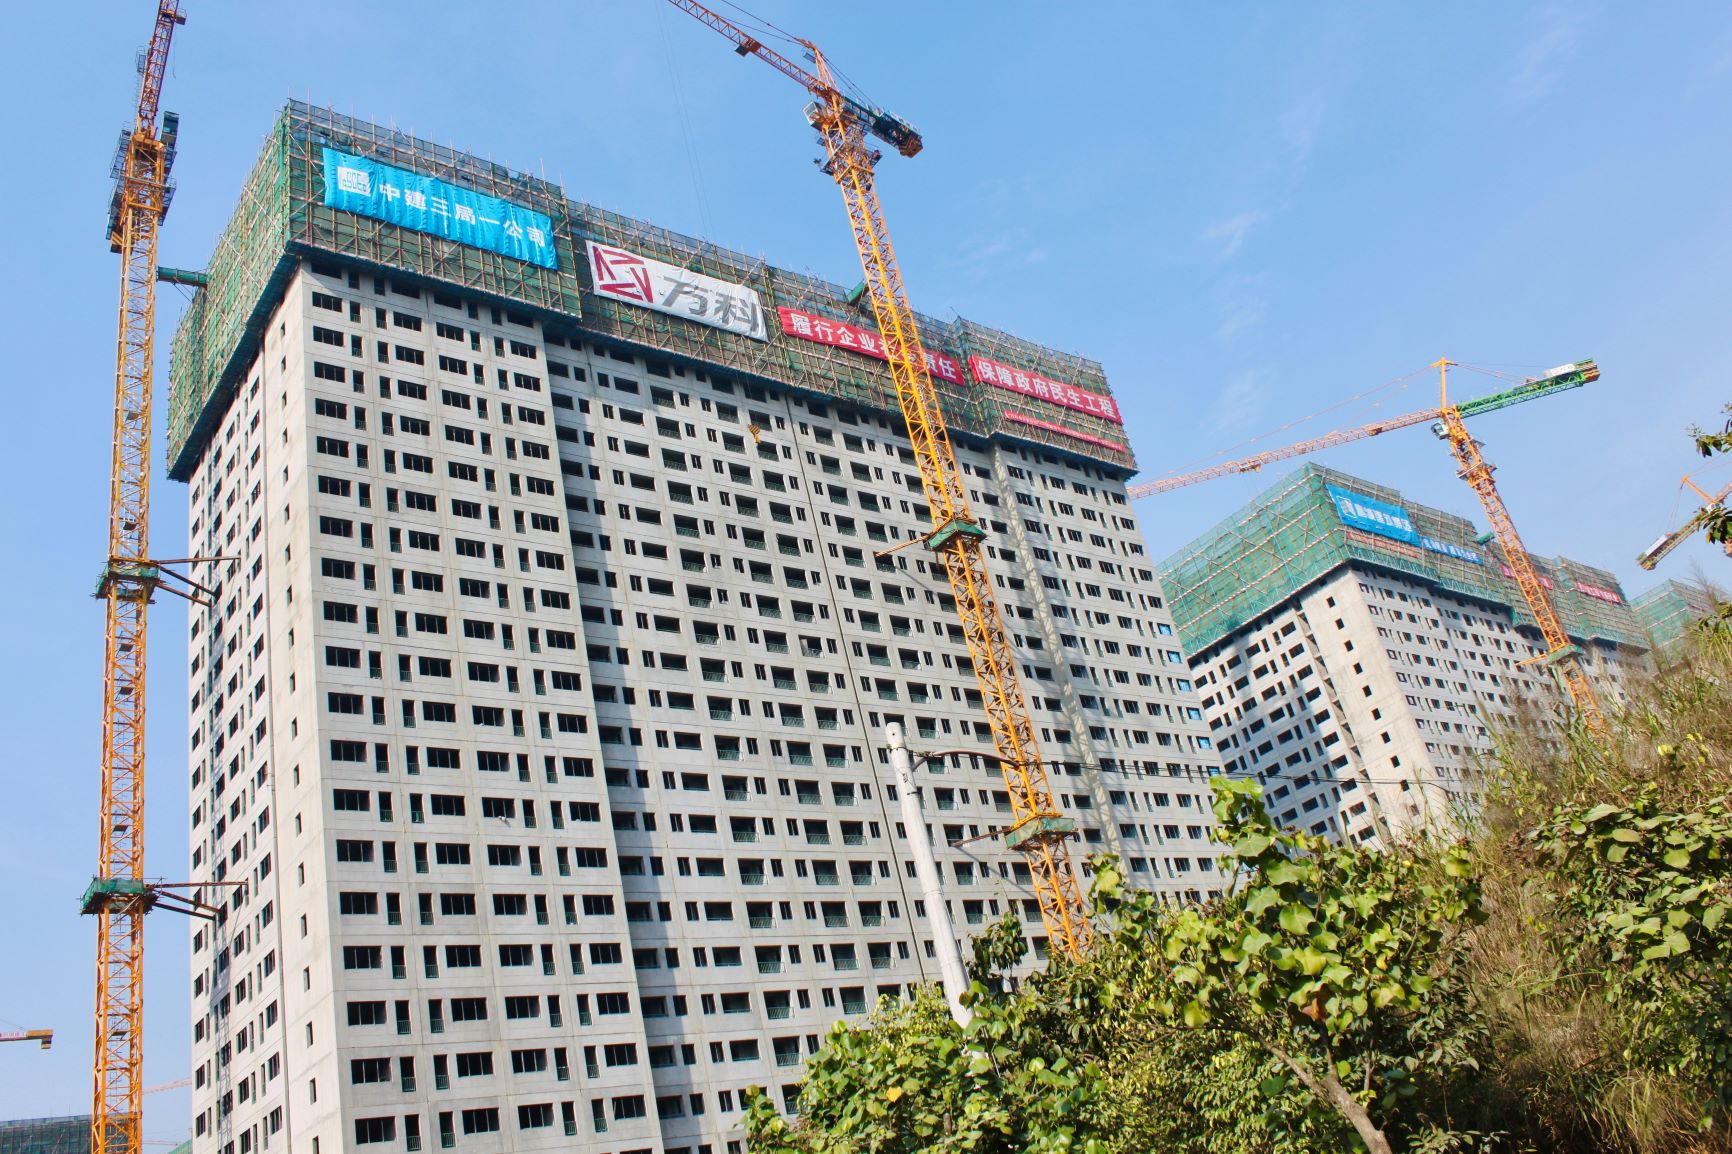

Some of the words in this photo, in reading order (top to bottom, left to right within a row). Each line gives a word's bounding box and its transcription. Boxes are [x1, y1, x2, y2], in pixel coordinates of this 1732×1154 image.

[380, 183, 545, 247] 中建三局一公司
[662, 275, 760, 333] 万科
[978, 360, 1116, 419] 保障政府民生工程
